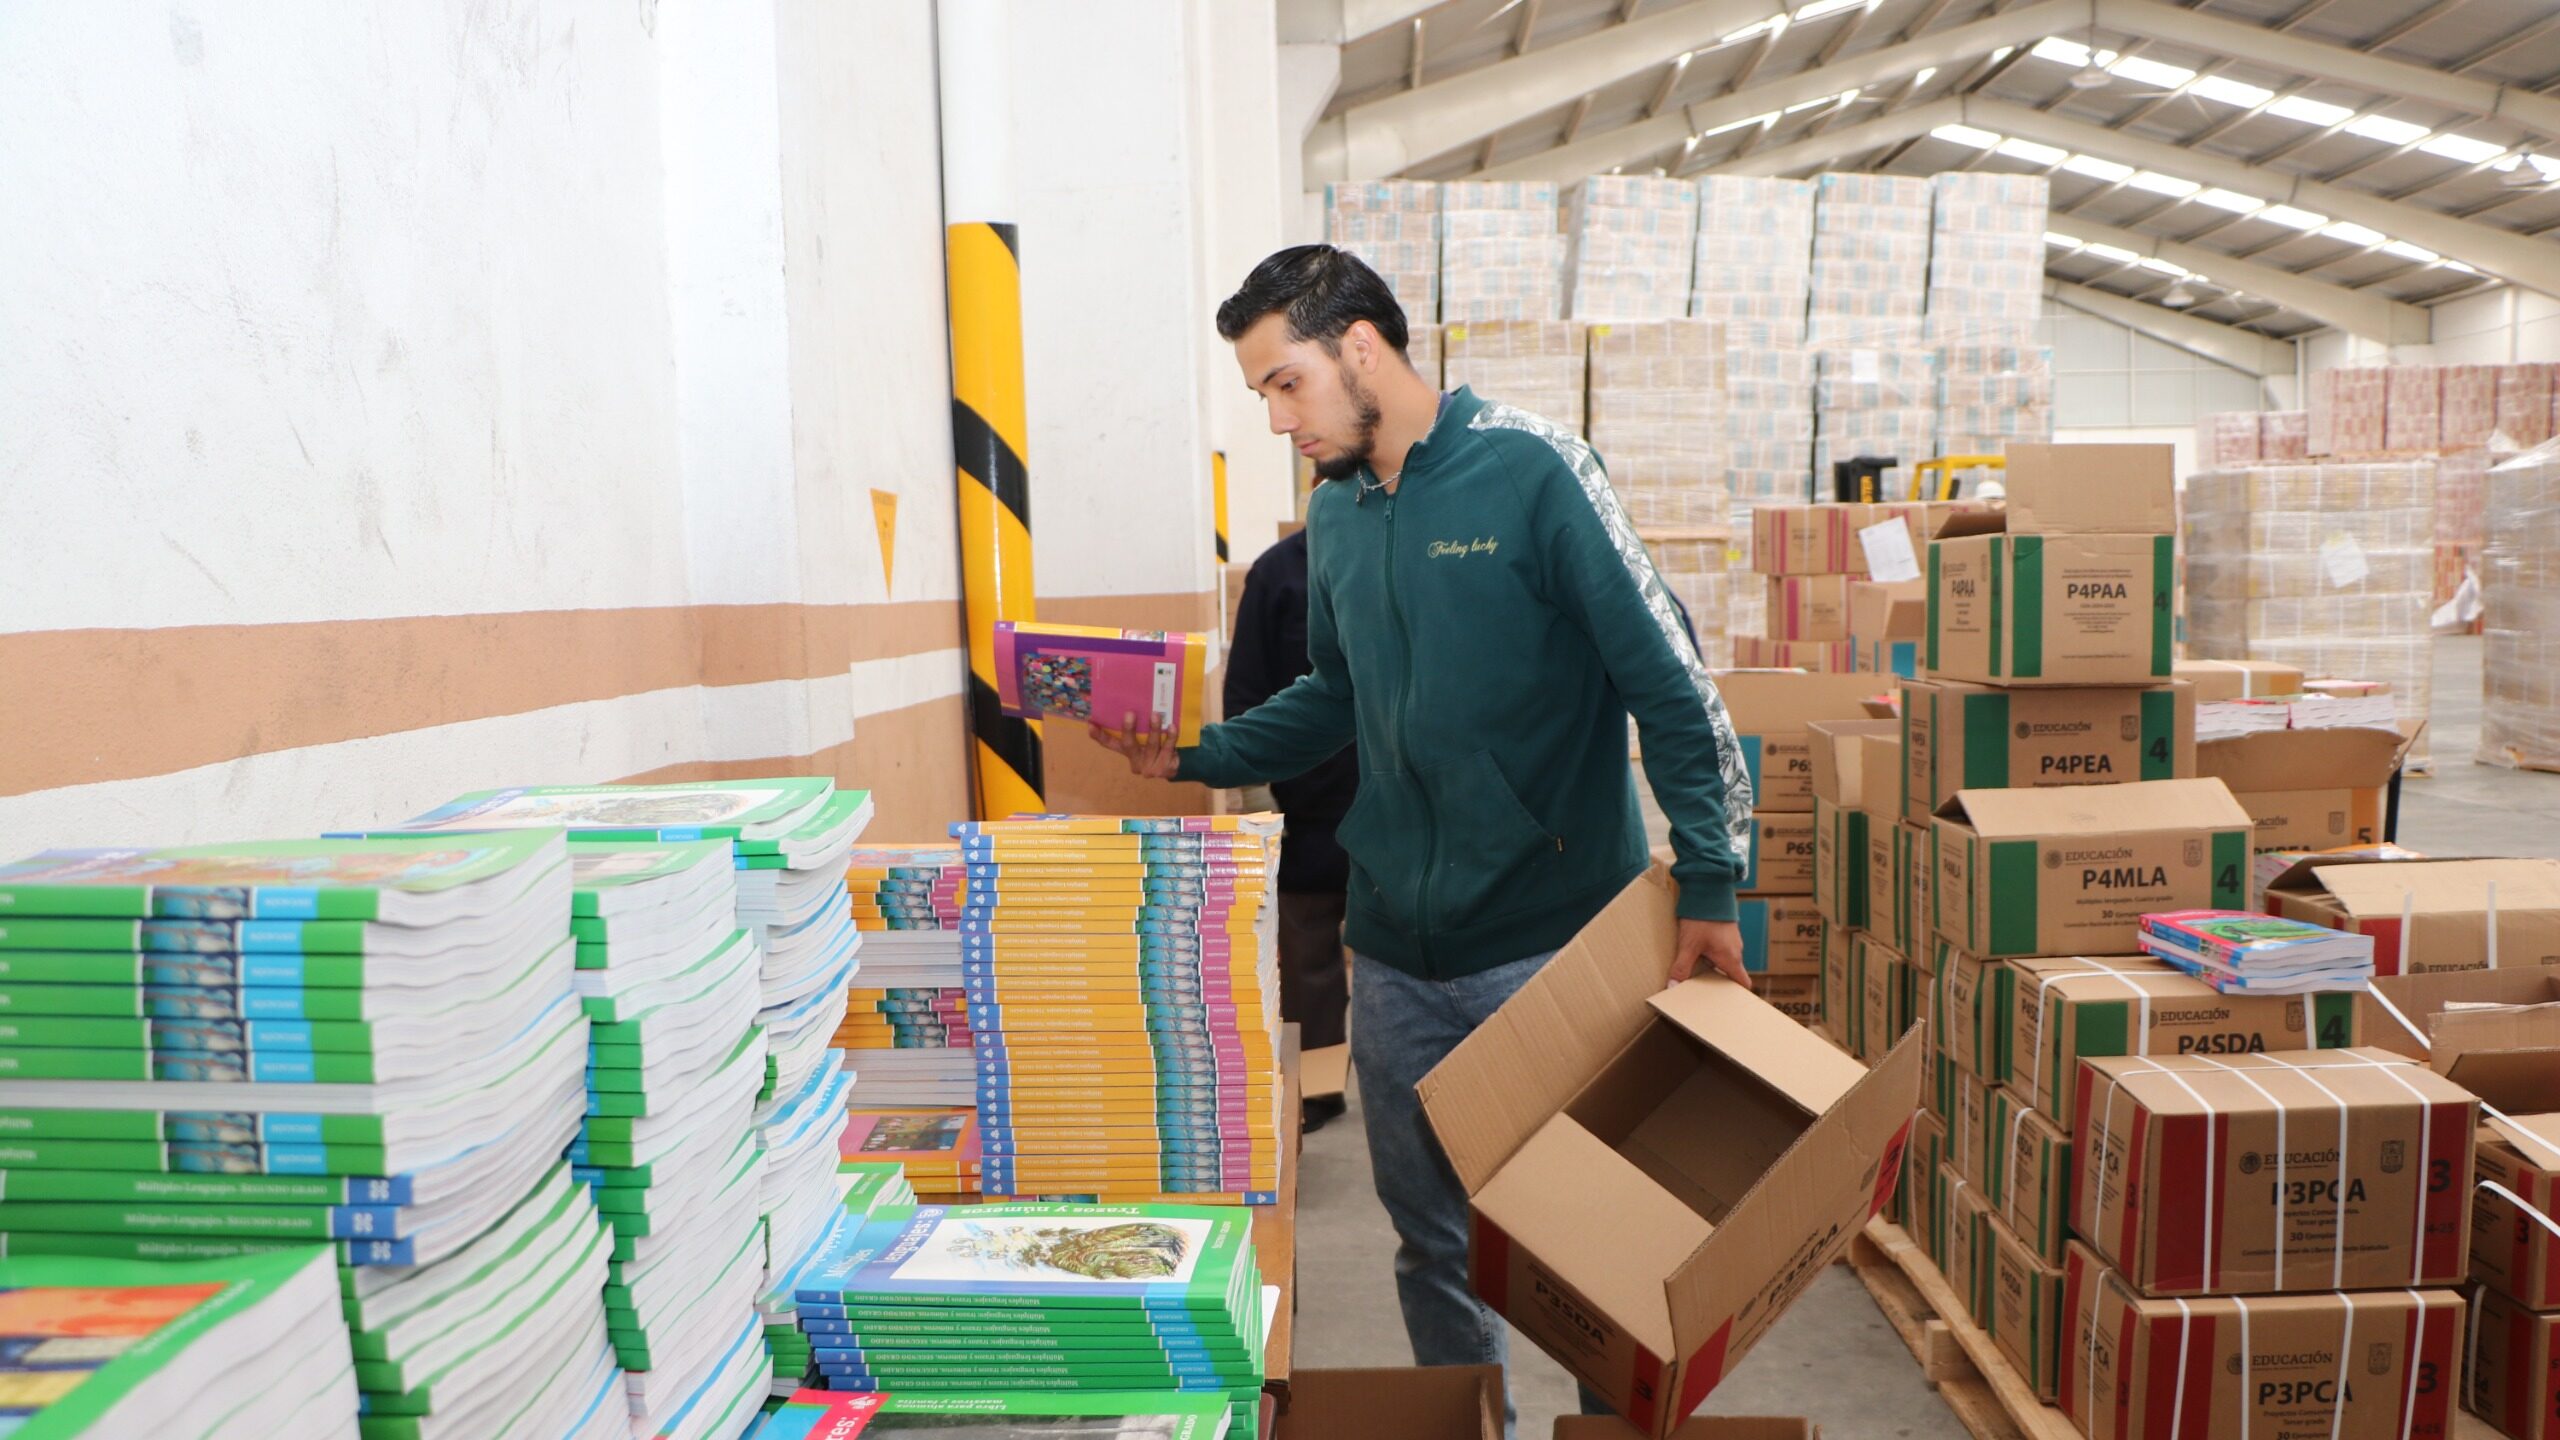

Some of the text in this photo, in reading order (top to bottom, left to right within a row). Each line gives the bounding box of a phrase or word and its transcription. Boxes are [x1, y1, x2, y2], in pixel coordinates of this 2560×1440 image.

[1428, 540, 1468, 559] Feeling
[1952, 579, 1976, 598] P4PAA
[2067, 583, 2127, 599] P4PAA
[2154, 592, 2169, 611] 4
[2033, 721, 2092, 732] EDUCACIÓN
[2149, 737, 2168, 763] 4
[2040, 755, 2112, 774] P4PEA
[2357, 827, 2372, 844] 5
[2065, 848, 2133, 862] EDUCACIÓN
[2082, 866, 2168, 890] P4MLA
[2217, 864, 2240, 894] 4
[2102, 910, 2113, 919] 30
[2160, 1008, 2230, 1022] EDUCACIÓN
[2321, 1016, 2345, 1048] 4
[2178, 1033, 2265, 1055] P4SDA
[2429, 1158, 2451, 1193] 3
[135, 1181, 186, 1194] Múltiples
[2271, 1178, 2366, 1205] P3PCA
[960, 1205, 1140, 1215] Trazos y números
[123, 1213, 172, 1226] Múltiples
[872, 1220, 933, 1263] lenguajes:
[2290, 1232, 2304, 1241] 30
[137, 1242, 185, 1255] Múltiples
[1768, 1222, 1838, 1304] P3SDA
[972, 1296, 1007, 1304] lenguajes:
[1008, 1297, 1040, 1305] Múltiples
[978, 1311, 1011, 1319] lenguajes:
[1013, 1312, 1045, 1320] Múltiples
[1535, 1278, 1605, 1346] P3SDA
[983, 1325, 1017, 1333] lenguajes:
[1019, 1325, 1051, 1334] Múltiples
[990, 1338, 1025, 1347] lenguajes:
[998, 1353, 1031, 1361] lenguajes:
[1032, 1353, 1064, 1361] Múltiples
[2252, 1351, 2333, 1366] EDUCACIÓN
[1000, 1366, 1035, 1374] lenguajes:
[1036, 1366, 1069, 1374] Múltiples
[1010, 1378, 1045, 1387] lenguajes:
[1046, 1378, 1078, 1386] Múltiples
[2416, 1362, 2439, 1394] 3
[2258, 1380, 2353, 1405] P3PCA
[2277, 1431, 2290, 1440] 30
